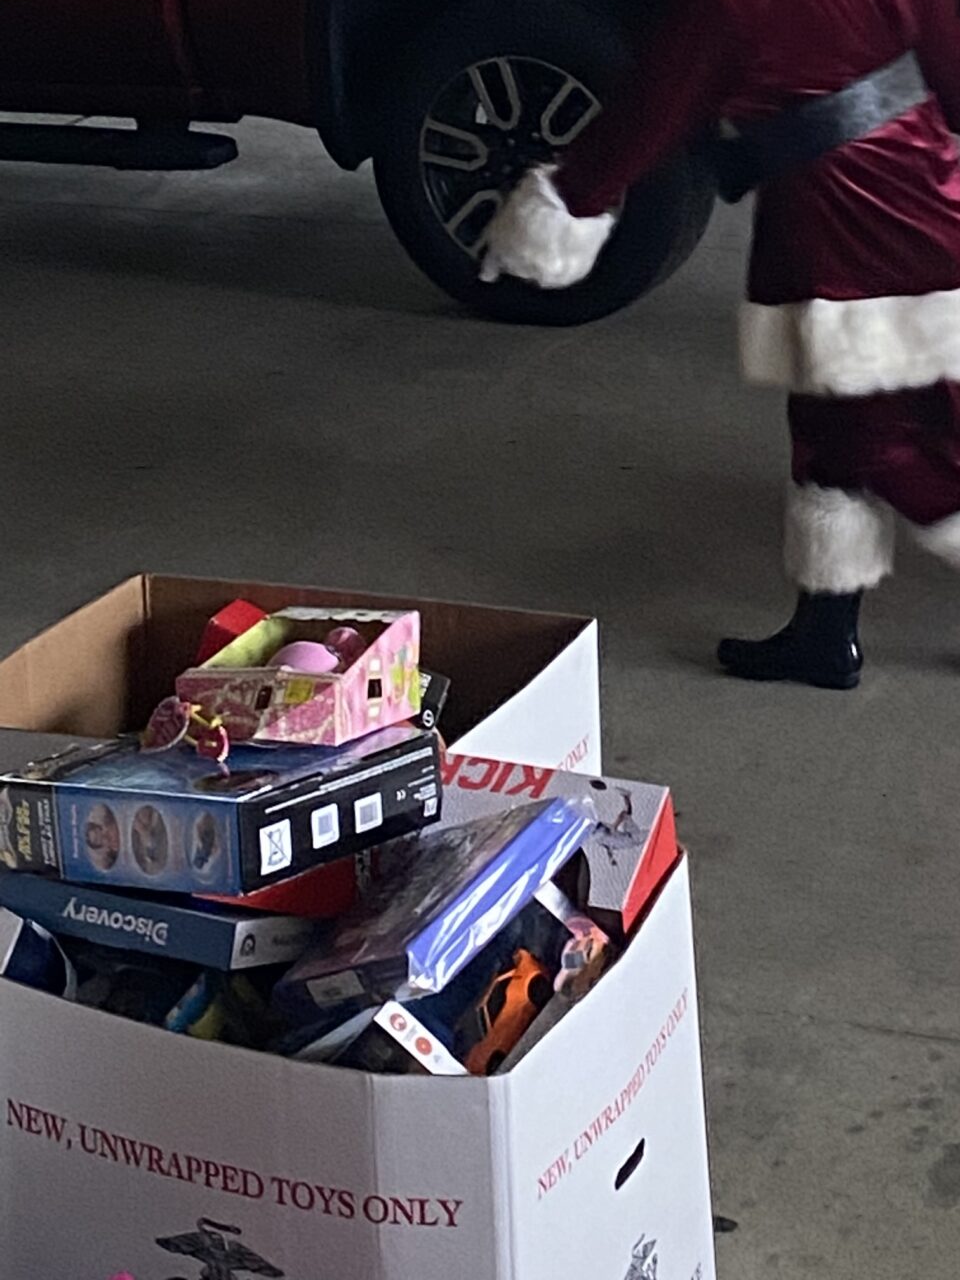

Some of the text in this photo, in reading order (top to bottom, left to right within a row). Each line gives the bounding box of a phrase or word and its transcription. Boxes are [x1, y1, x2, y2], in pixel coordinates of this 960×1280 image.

[62, 897, 169, 946] Discovery
[537, 987, 689, 1200] NEW, UNWRAPPED TOYS ONLY
[7, 1098, 464, 1228] NEW, UNWRAPPED TOYS ONLY
